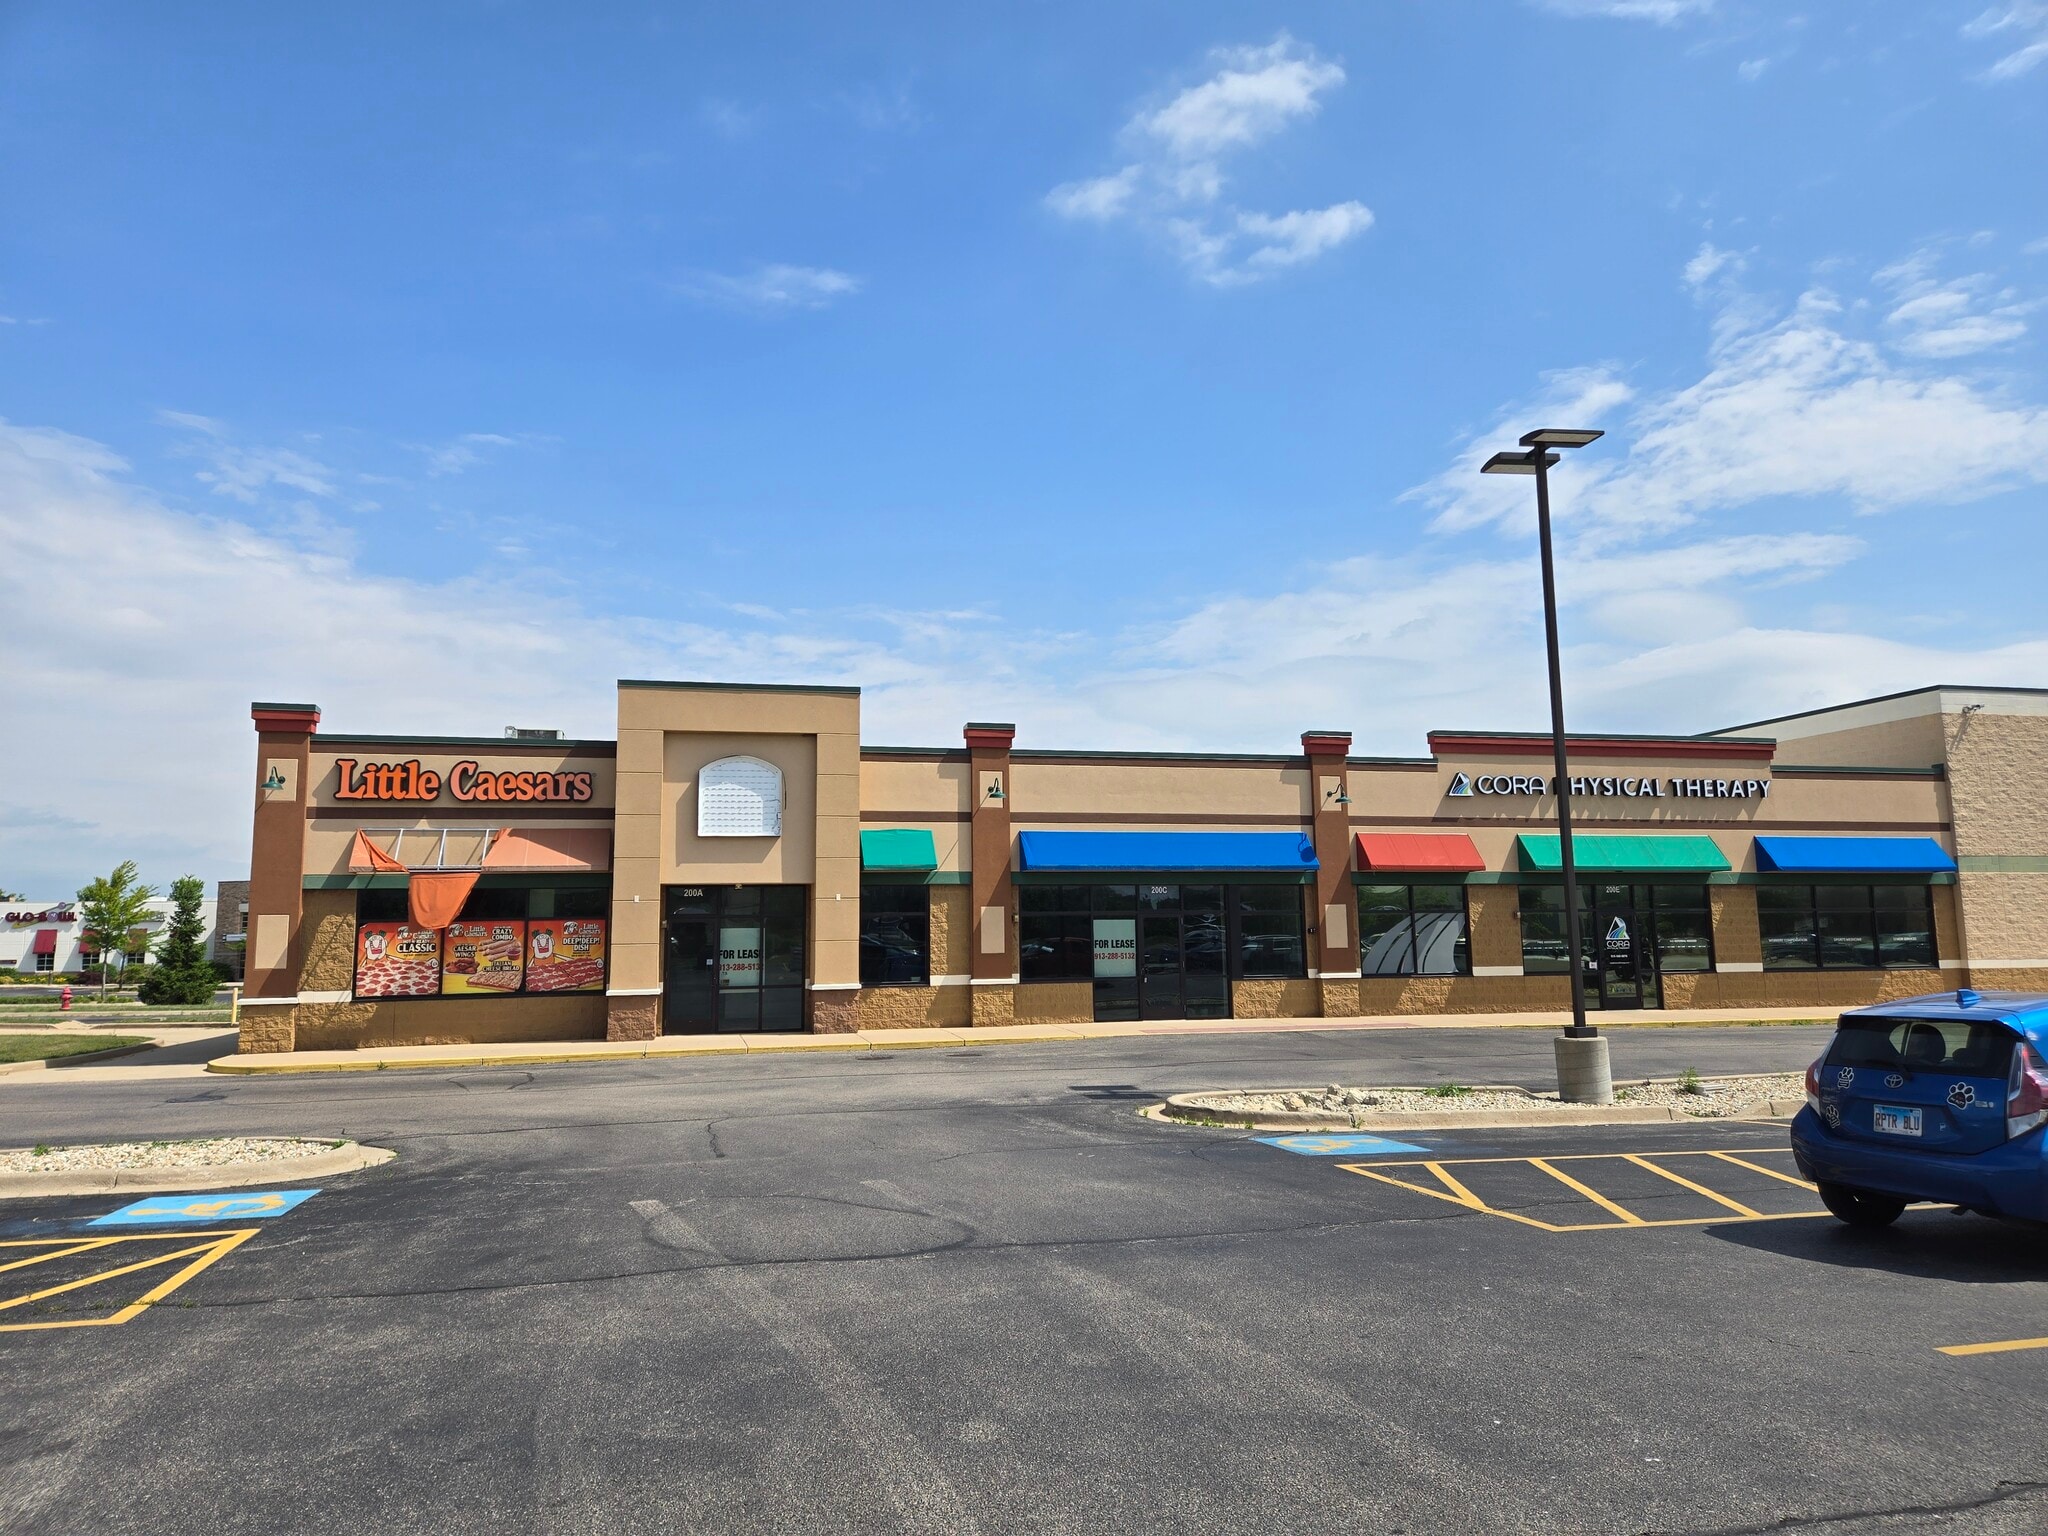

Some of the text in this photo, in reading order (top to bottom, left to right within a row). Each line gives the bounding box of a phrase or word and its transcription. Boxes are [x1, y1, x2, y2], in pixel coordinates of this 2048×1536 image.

[334, 758, 594, 802] Little Caesars
[1477, 775, 1771, 798] CORA HYSICAL THERAPY
[684, 889, 703, 897] 200A
[1151, 886, 1168, 894] 200C
[397, 943, 436, 952] CLASSIC
[1094, 939, 1135, 948] FOR LEASE
[1606, 940, 1630, 948] CORA
[737, 949, 760, 959] LEAS
[1875, 1112, 1920, 1131] RPTR BLU
